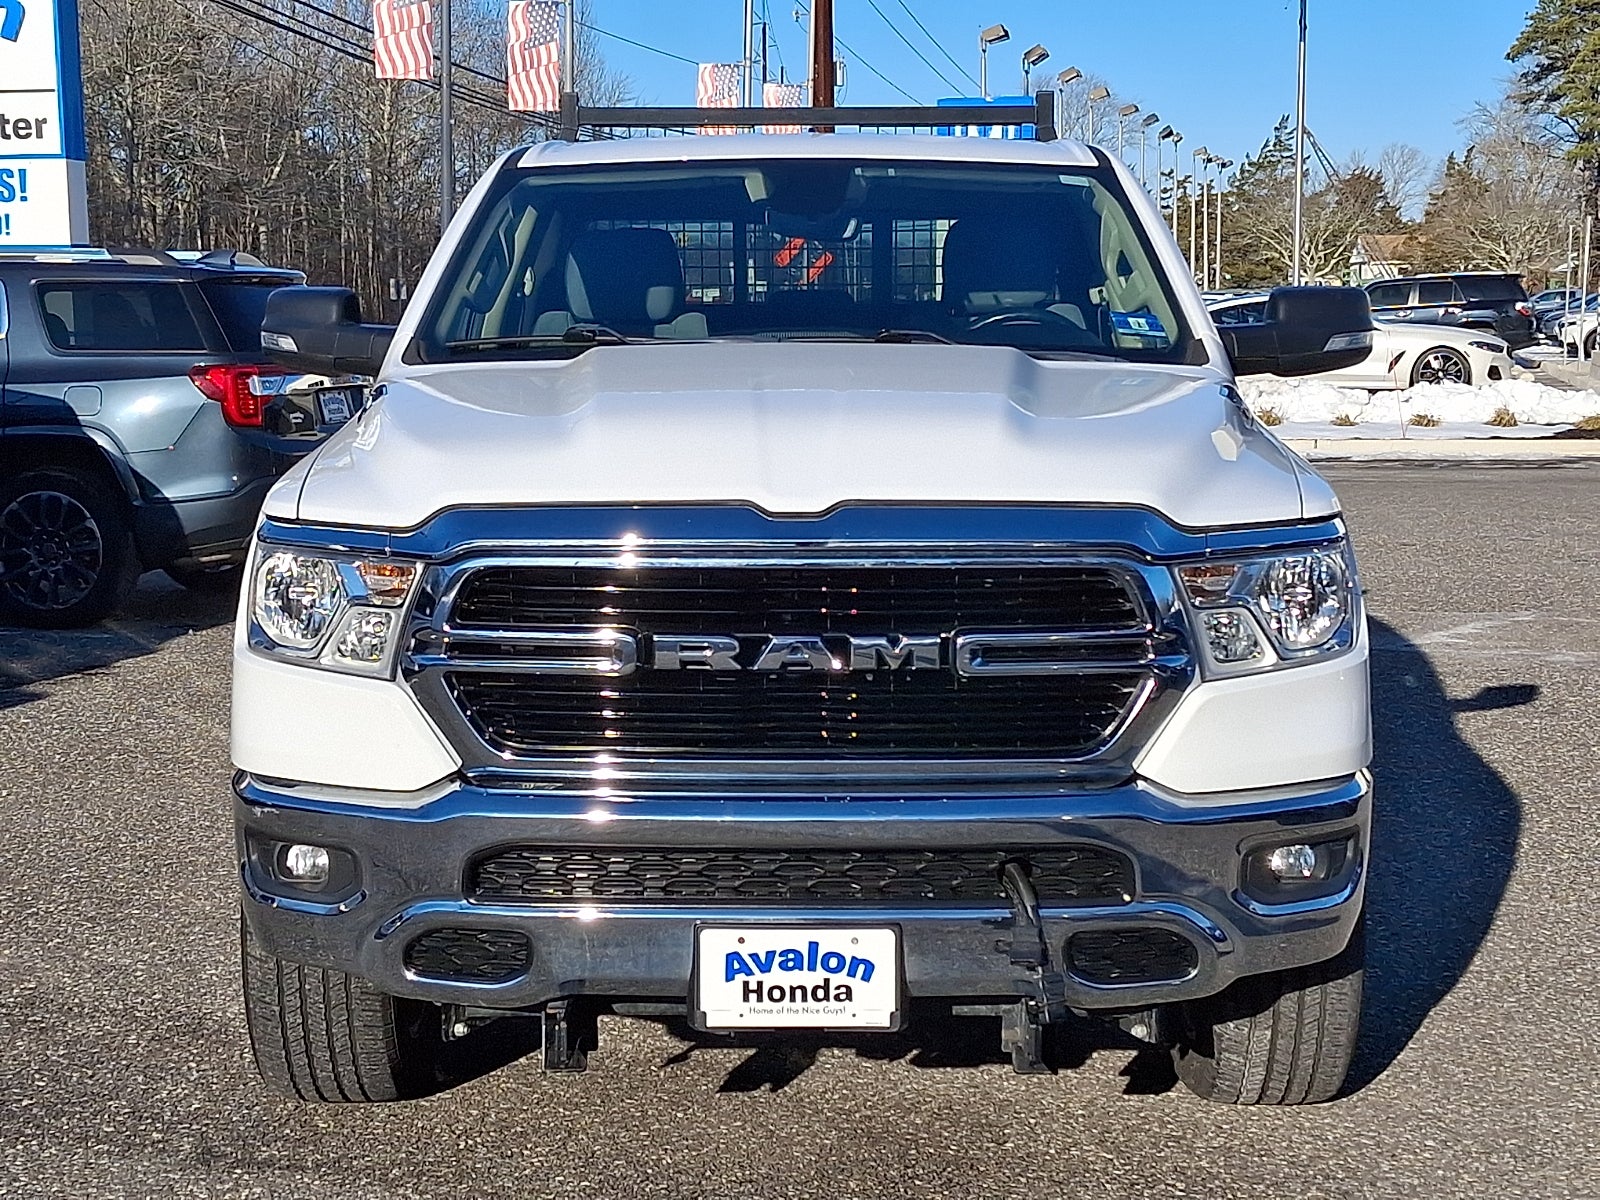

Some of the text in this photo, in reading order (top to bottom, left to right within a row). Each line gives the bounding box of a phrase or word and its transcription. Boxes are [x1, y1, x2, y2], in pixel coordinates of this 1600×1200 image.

[652, 634, 941, 670] RAM
[725, 941, 875, 982] Avalon
[742, 978, 853, 1003] Honda
[749, 1005, 846, 1016] Home of the Nice Guys!
